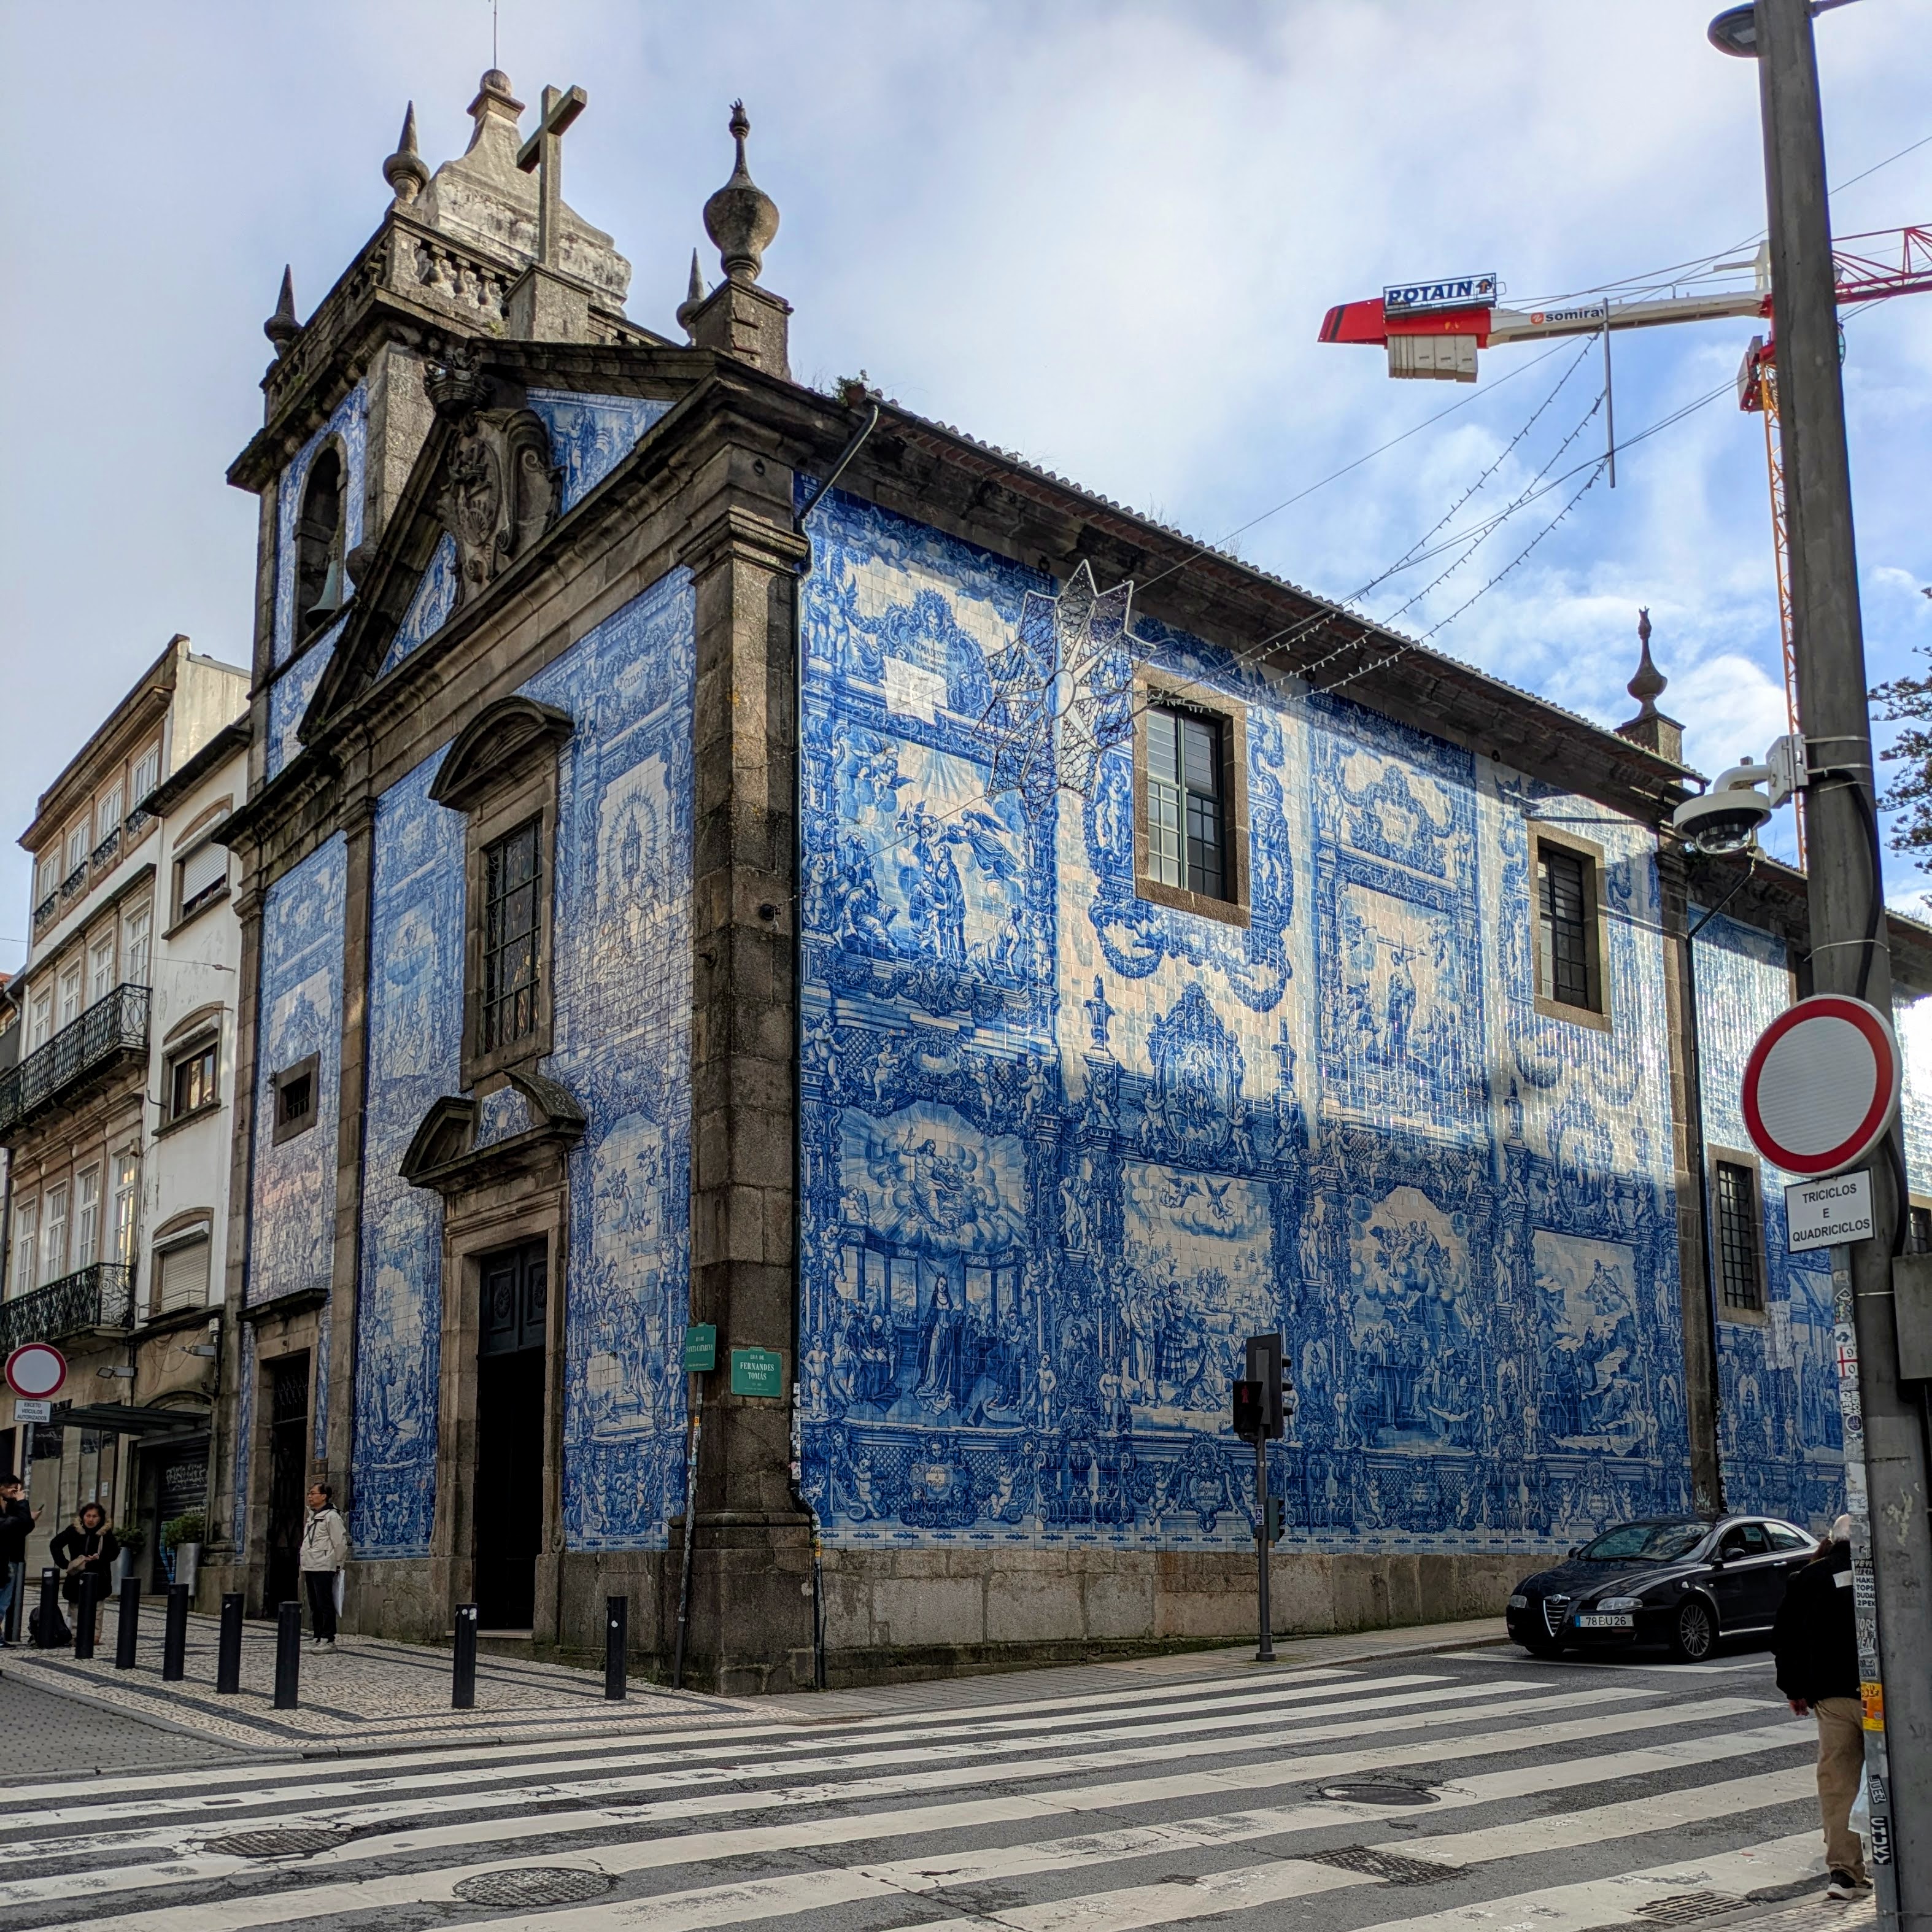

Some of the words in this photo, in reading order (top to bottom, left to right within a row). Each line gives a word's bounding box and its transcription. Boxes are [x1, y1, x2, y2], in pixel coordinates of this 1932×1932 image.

[1388, 280, 1472, 306] POTAIN
[1802, 1183, 1857, 1204] TRICICLOS
[1823, 1208, 1830, 1218] E
[1793, 1218, 1870, 1242] QUADRICICLOS
[740, 1361, 775, 1372] FERNANDES
[748, 1371, 767, 1380] TOMÁS
